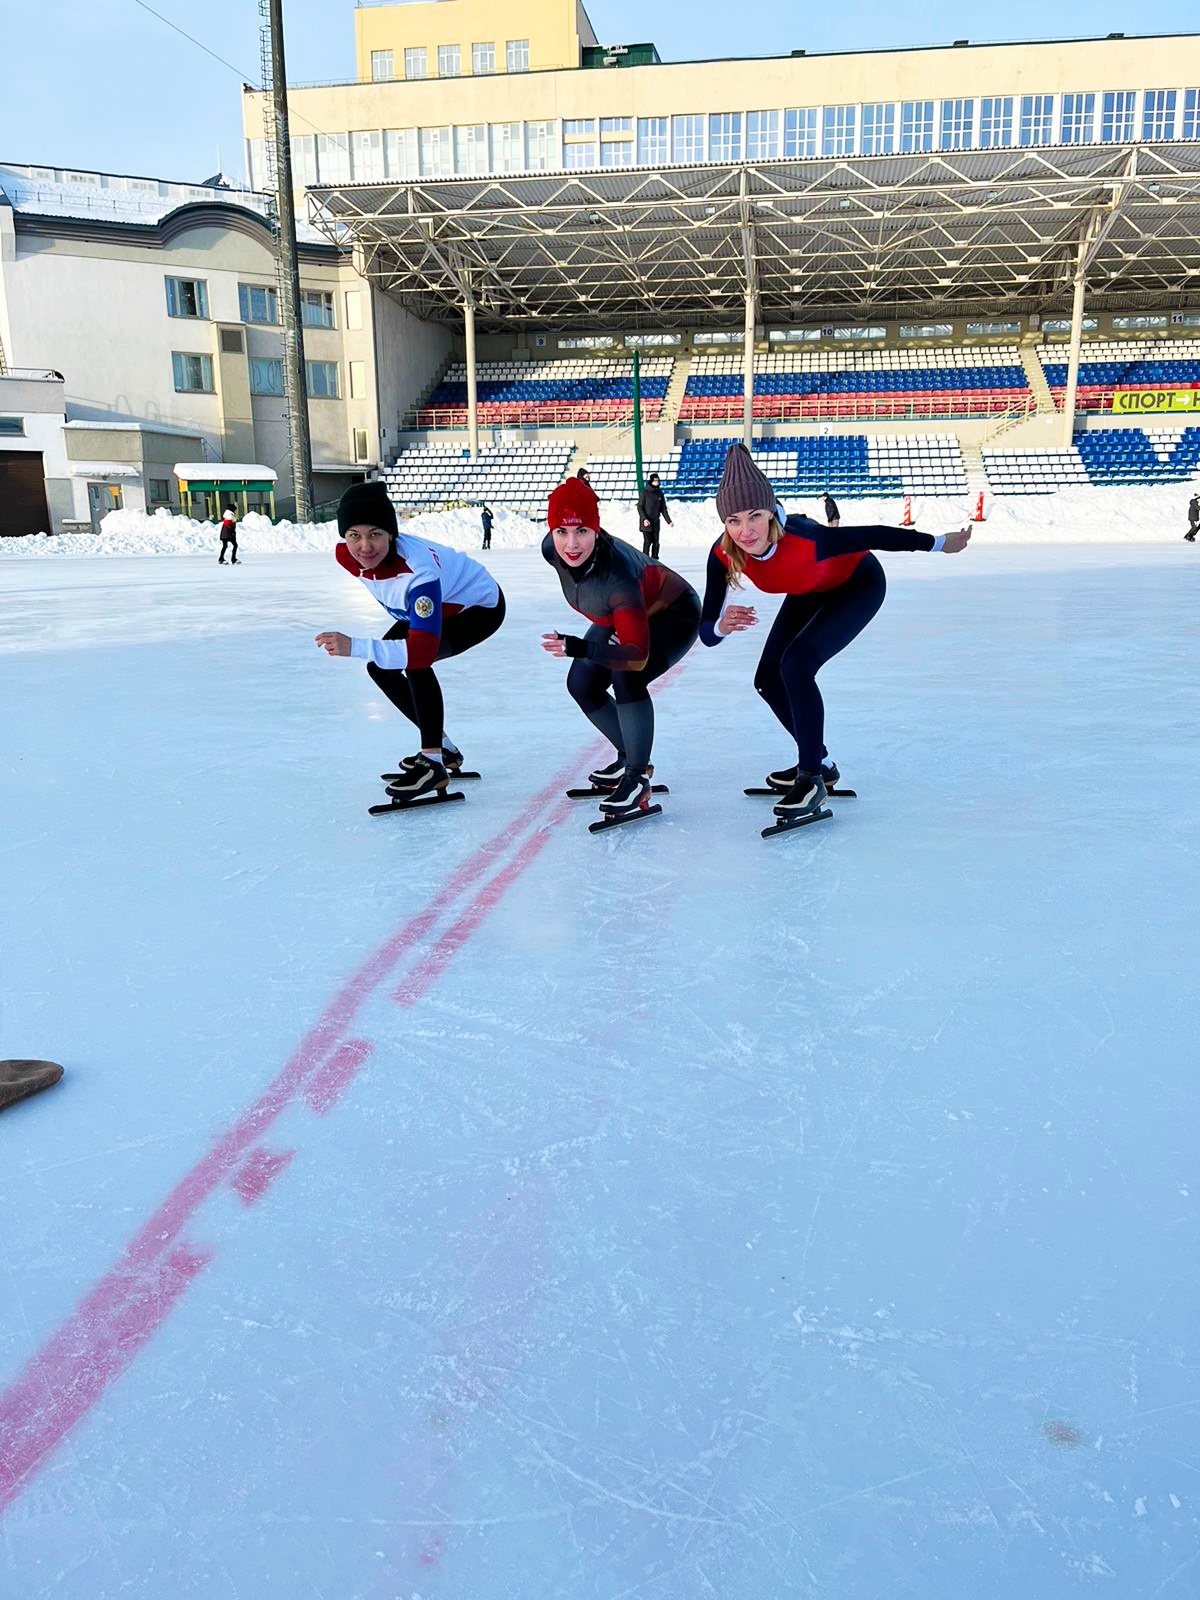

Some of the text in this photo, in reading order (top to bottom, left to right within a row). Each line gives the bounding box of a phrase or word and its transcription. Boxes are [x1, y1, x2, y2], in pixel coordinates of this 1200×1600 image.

[1172, 315, 1182, 323] 11
[822, 328, 833, 336] 10
[1119, 392, 1177, 409] СПОРТ
